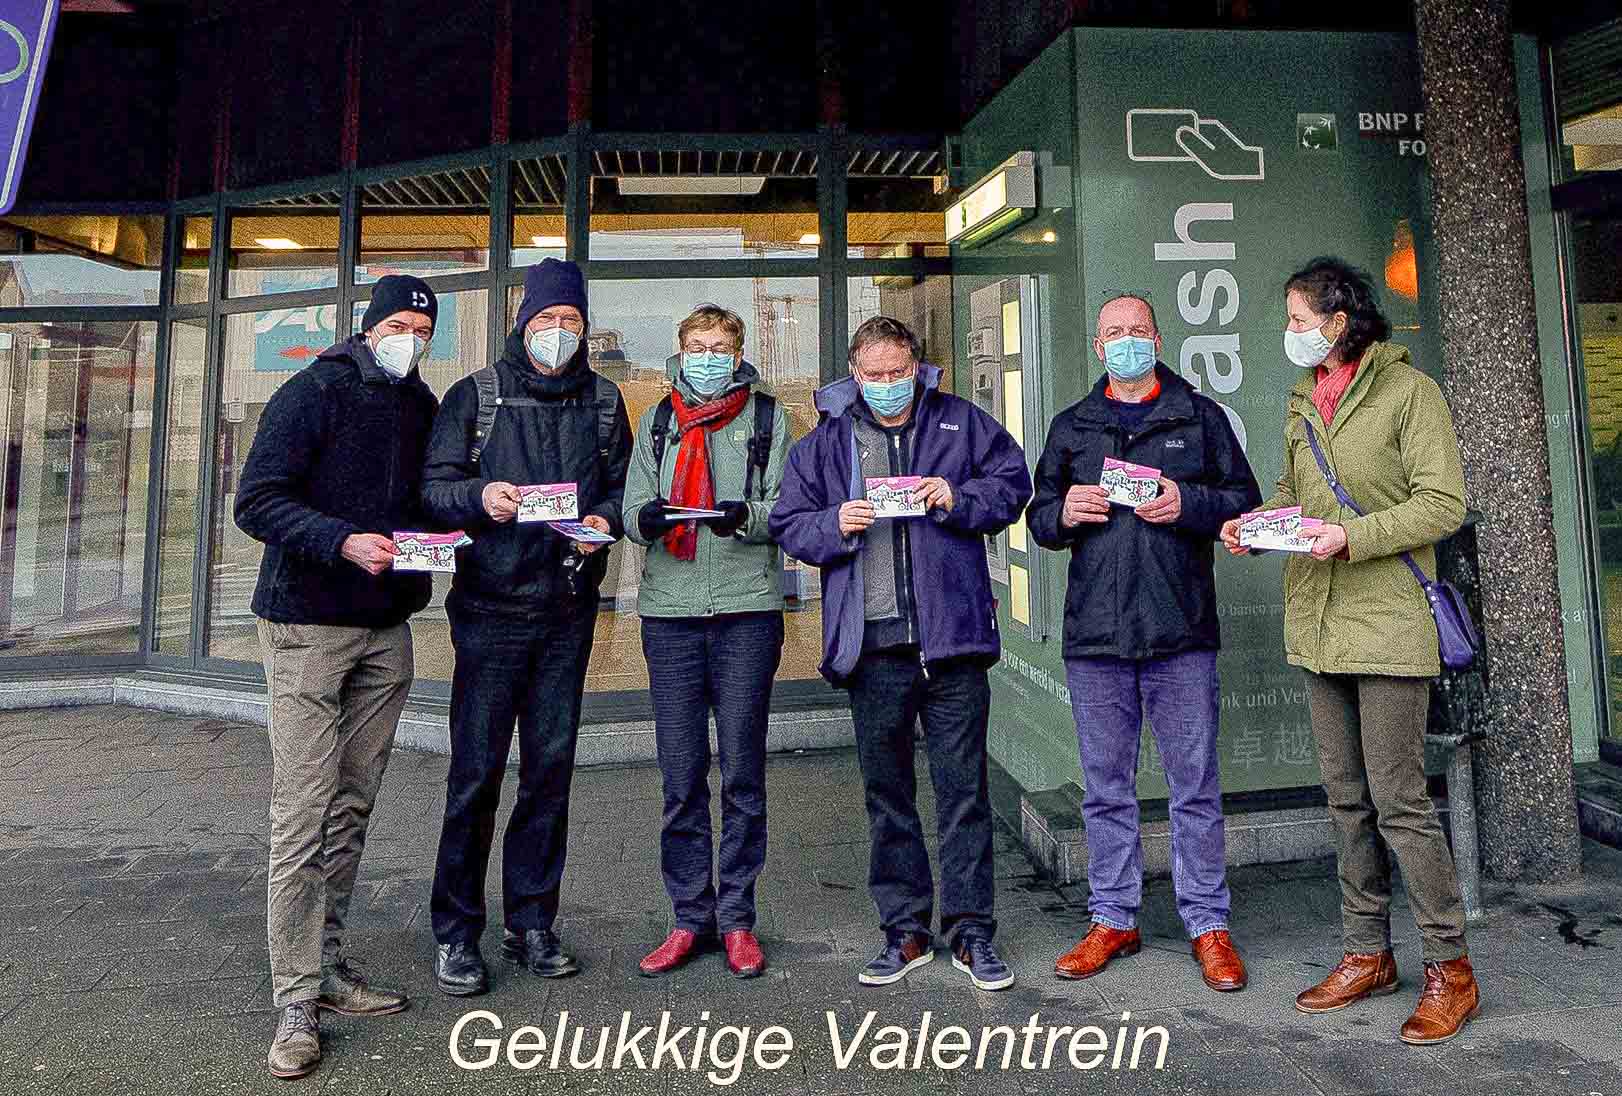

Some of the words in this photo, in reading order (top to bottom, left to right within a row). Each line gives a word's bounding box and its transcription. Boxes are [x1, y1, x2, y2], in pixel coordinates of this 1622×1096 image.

[1358, 111, 1408, 131] BNP
[1154, 202, 1247, 452] ash
[1246, 688, 1277, 708] und
